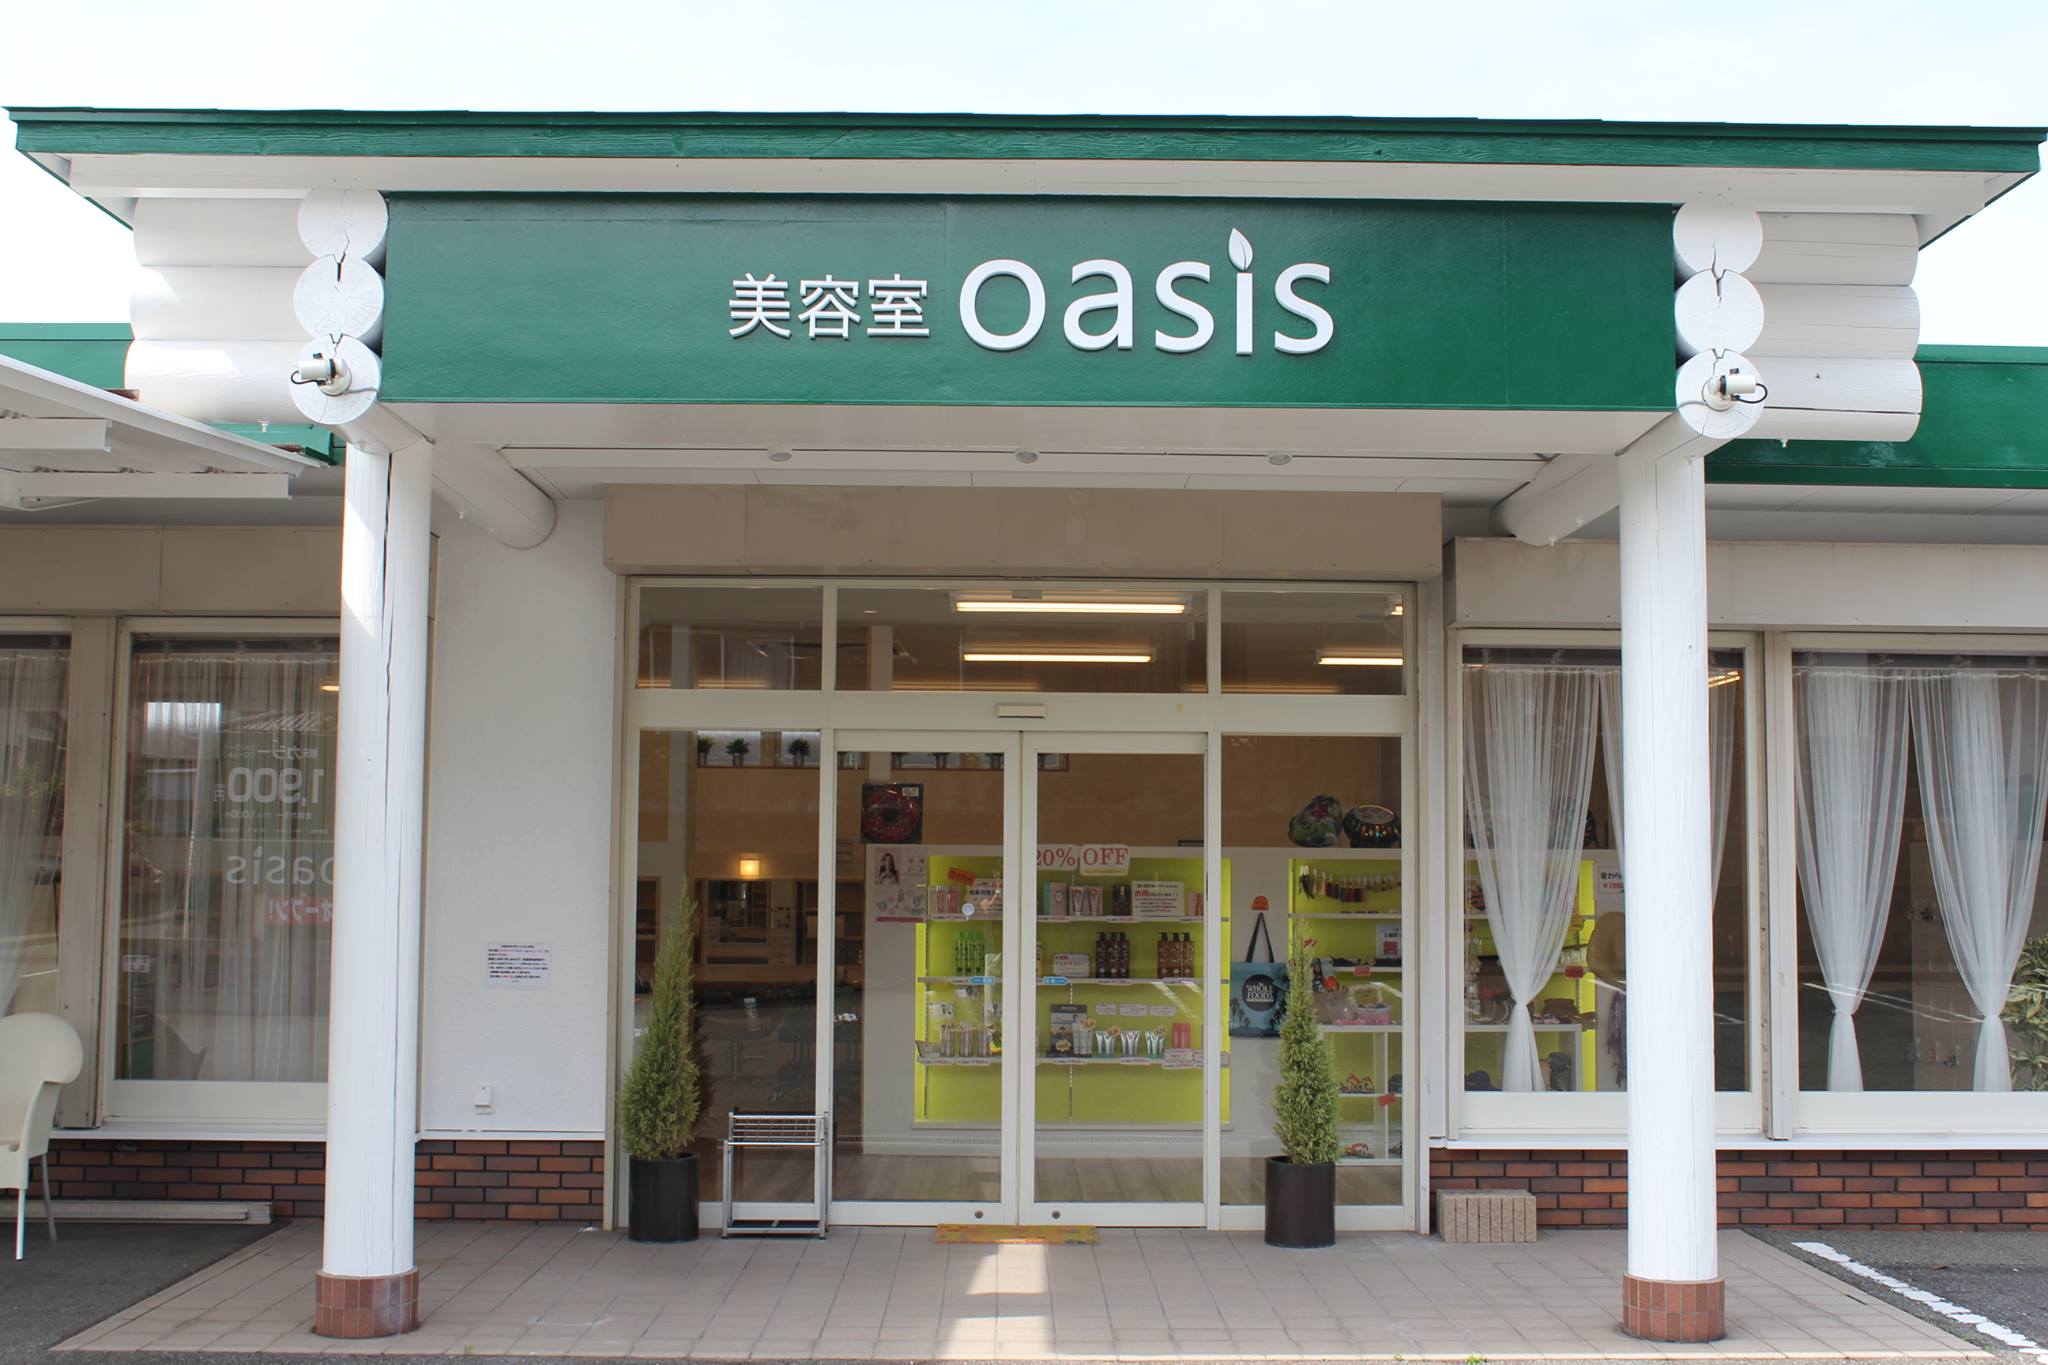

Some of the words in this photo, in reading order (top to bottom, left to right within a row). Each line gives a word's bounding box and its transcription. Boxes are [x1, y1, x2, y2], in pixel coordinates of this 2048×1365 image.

[728, 272, 931, 341] 美容室
[958, 228, 1335, 356] oasis
[1082, 847, 1129, 866] OFF
